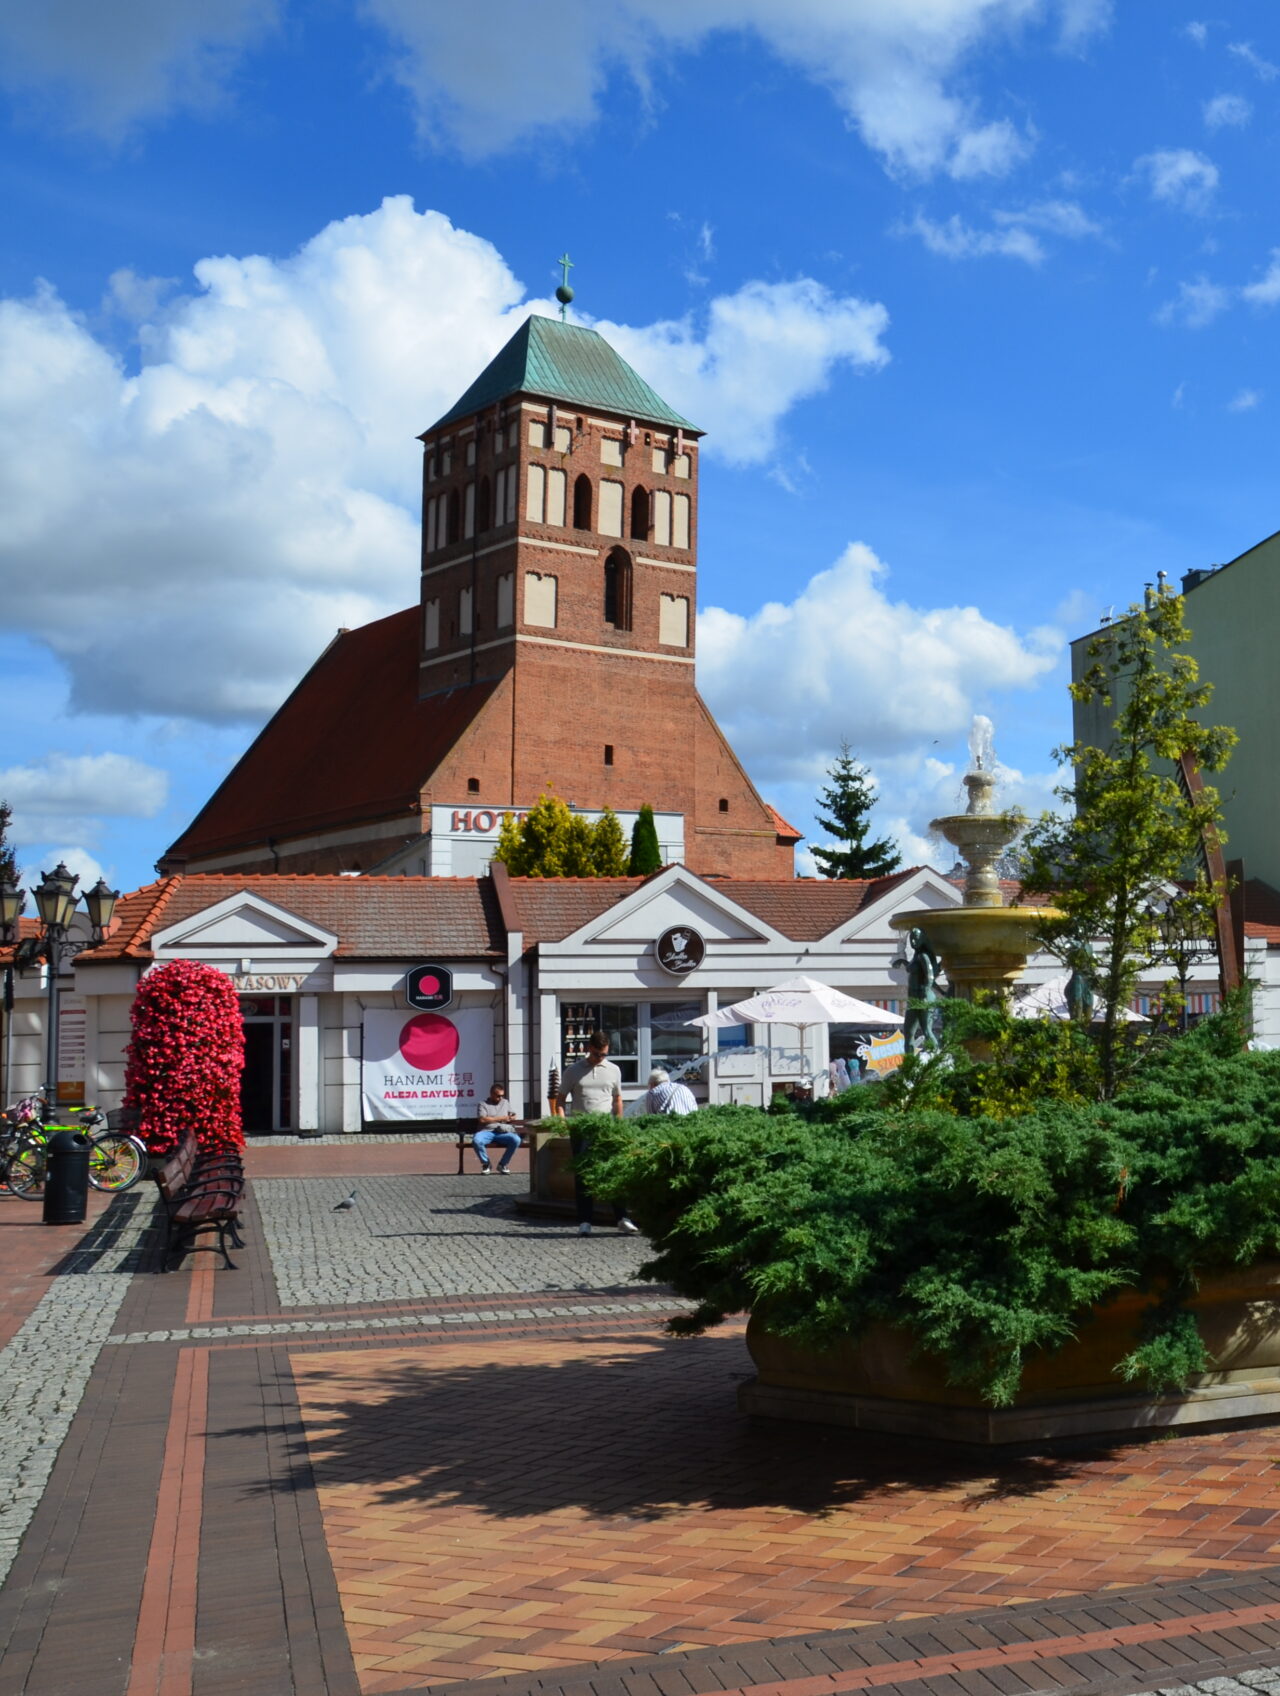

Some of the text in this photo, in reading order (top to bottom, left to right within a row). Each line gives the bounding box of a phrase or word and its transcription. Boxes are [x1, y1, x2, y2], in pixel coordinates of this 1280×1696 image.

[383, 1074, 444, 1086] HANAMI
[383, 1090, 419, 1099] ALEJA
[467, 1088, 475, 1097] 8
